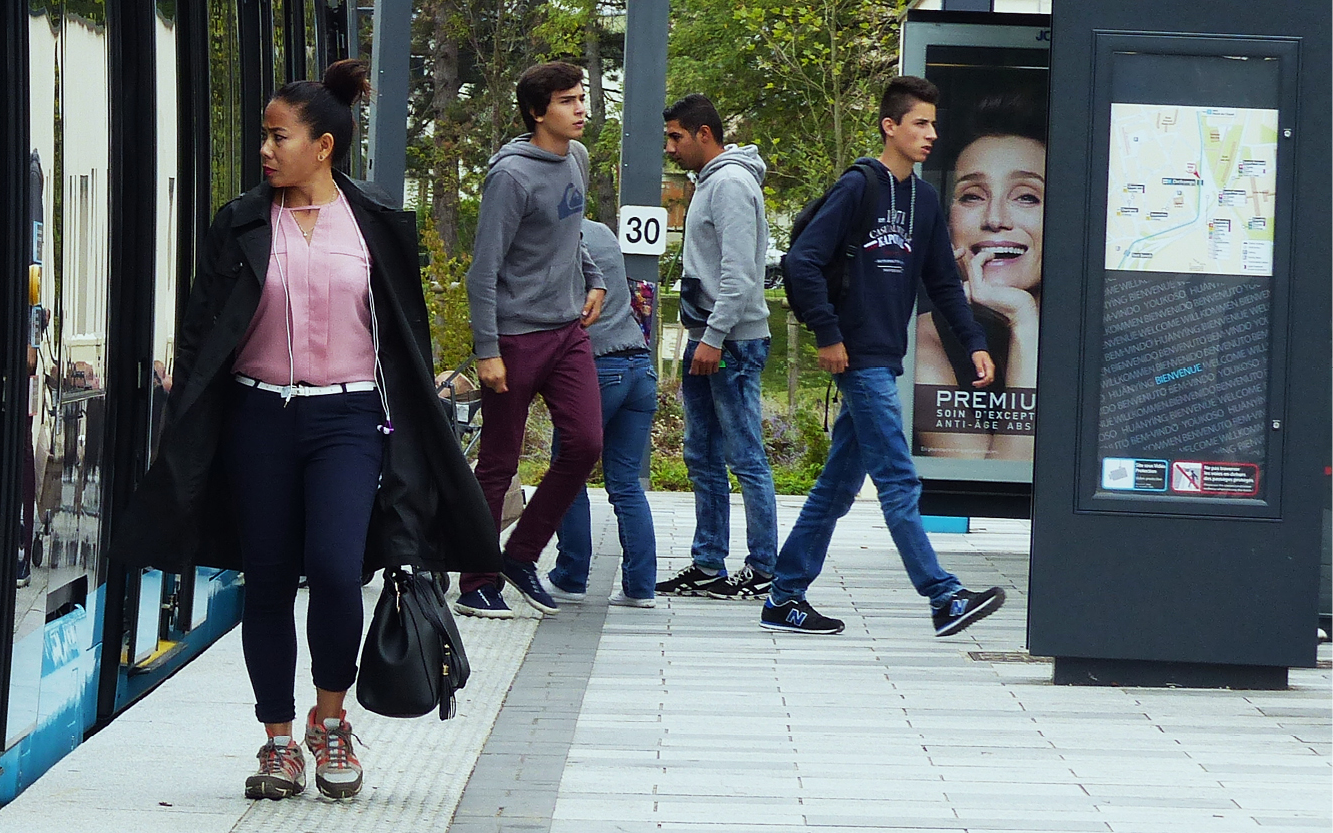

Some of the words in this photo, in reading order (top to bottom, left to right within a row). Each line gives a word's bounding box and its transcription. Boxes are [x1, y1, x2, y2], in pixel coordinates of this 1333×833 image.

[626, 216, 660, 244] 30
[1155, 363, 1201, 384] BIENVENUE
[936, 390, 1036, 410] PREMIU
[936, 409, 966, 418] SOIN
[975, 410, 1035, 421] D'EXCEPT
[935, 419, 999, 430] ANTI-ÂGE
[1006, 422, 1031, 431] ABS
[786, 608, 807, 627] N
[949, 599, 969, 617] N
